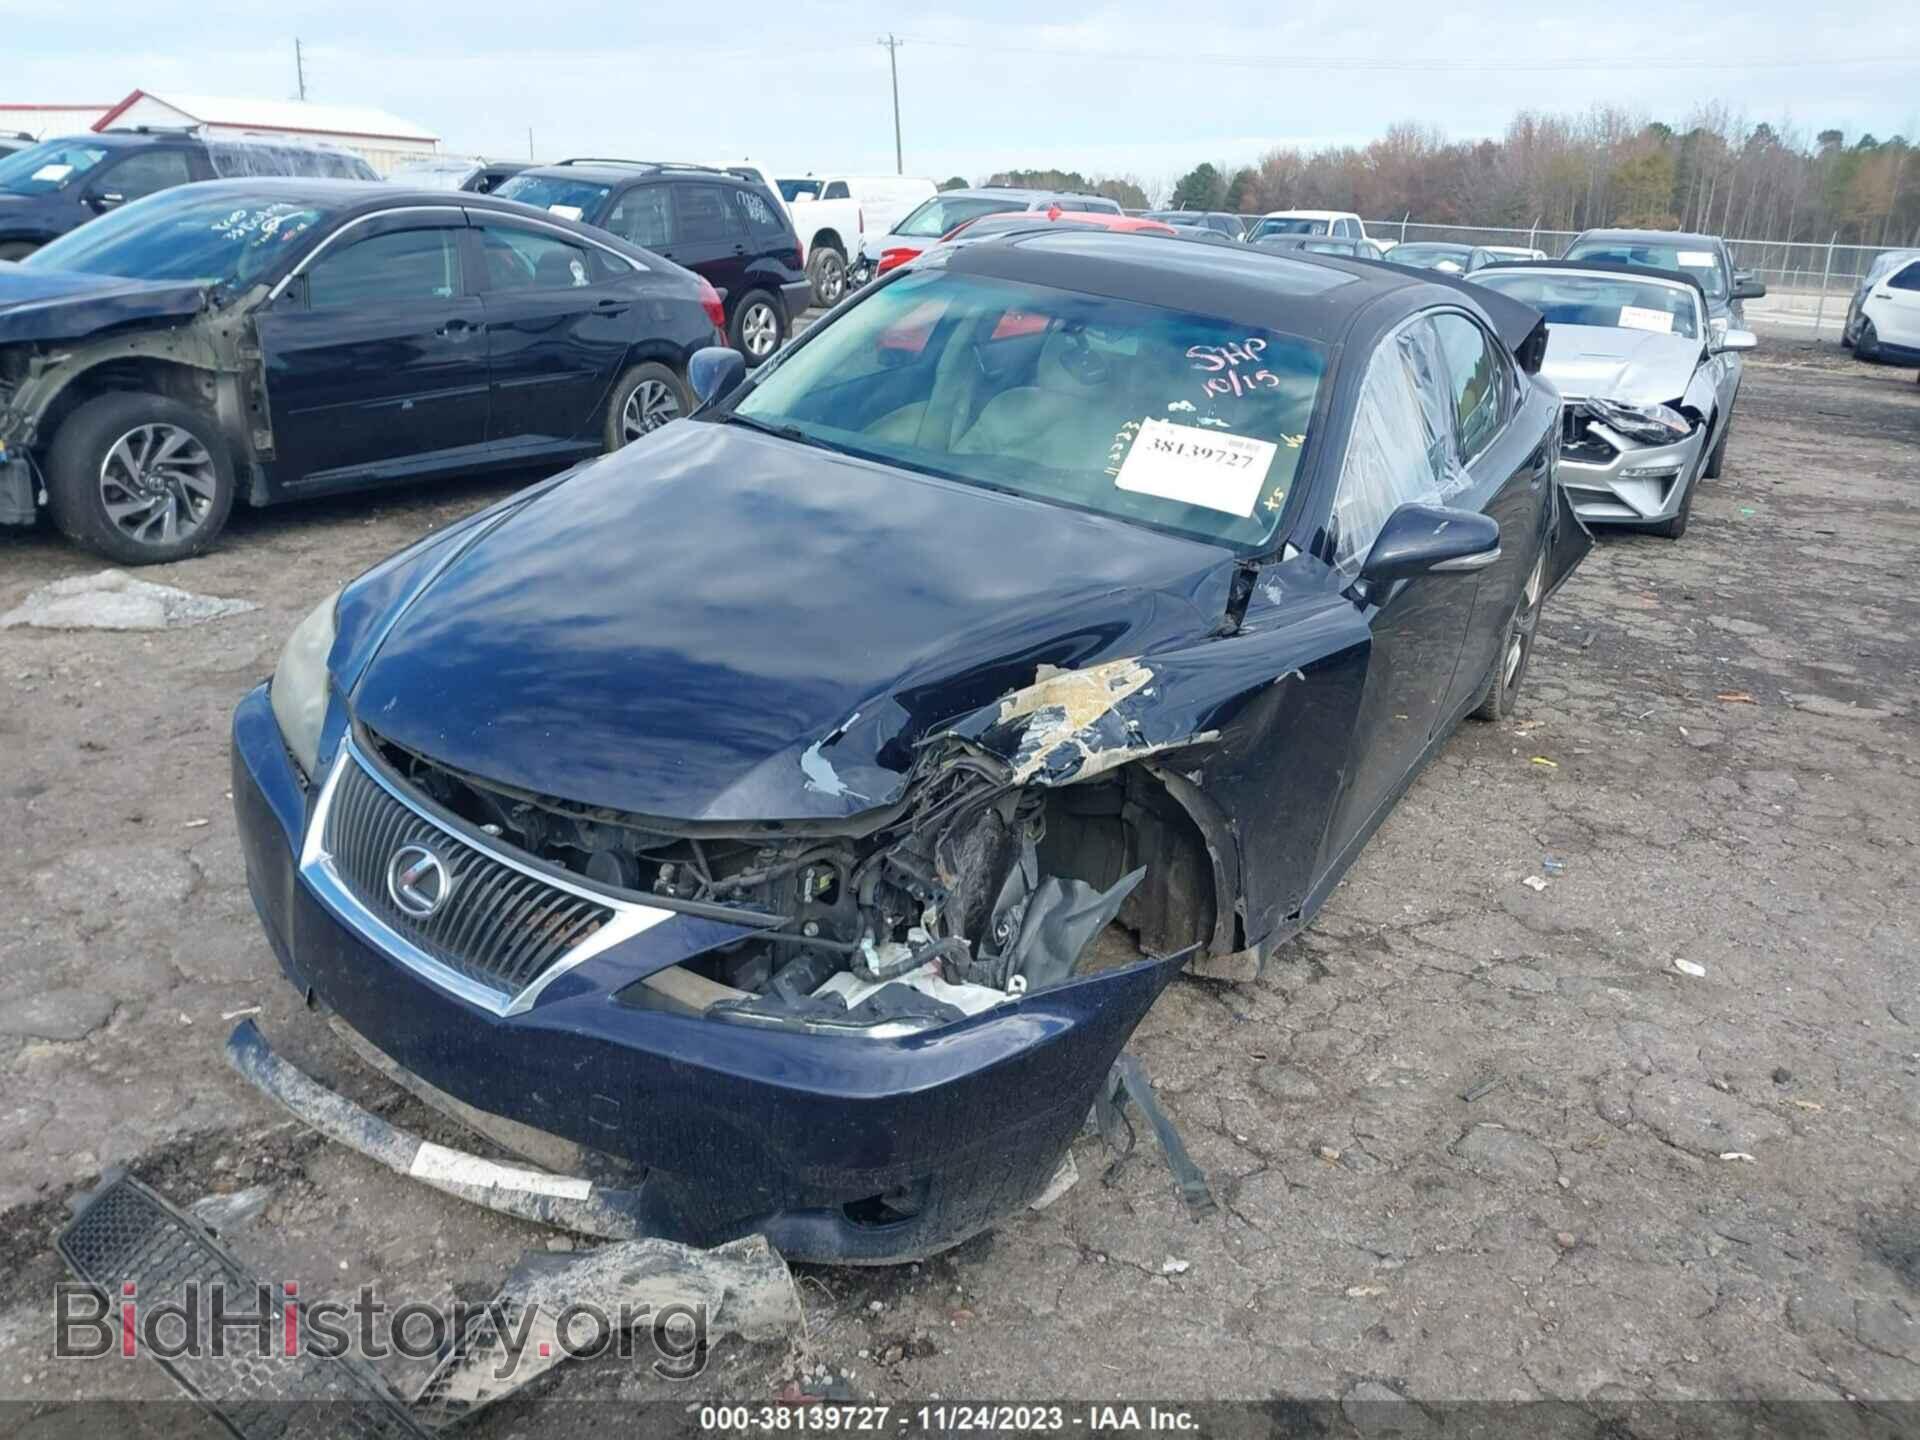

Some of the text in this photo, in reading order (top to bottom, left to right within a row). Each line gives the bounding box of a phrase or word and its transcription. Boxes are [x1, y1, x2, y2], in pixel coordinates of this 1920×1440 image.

[1185, 337, 1267, 371] SHP
[1201, 369, 1280, 398] 10/15
[1145, 437, 1254, 469] 38139727
